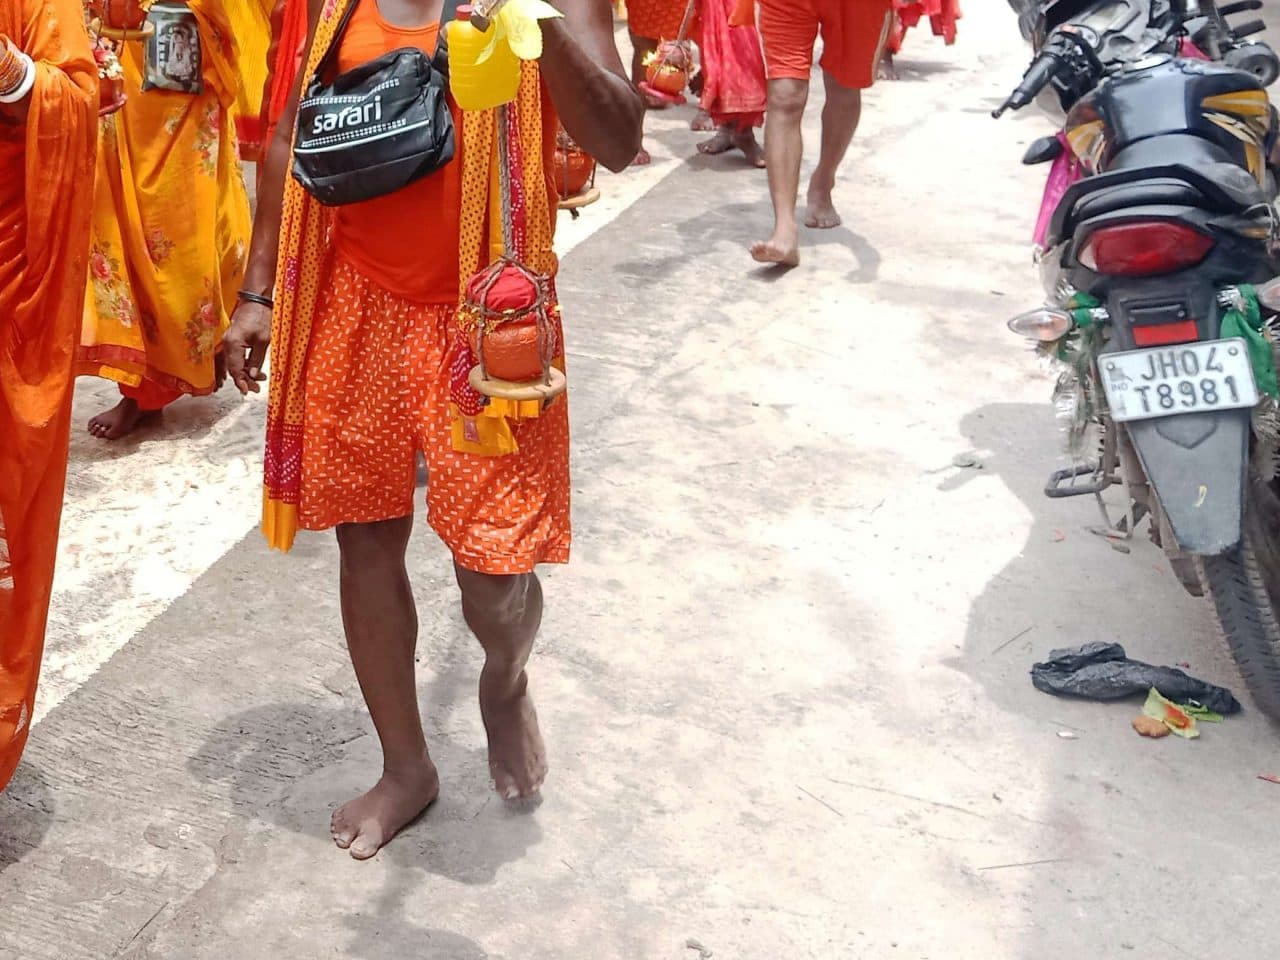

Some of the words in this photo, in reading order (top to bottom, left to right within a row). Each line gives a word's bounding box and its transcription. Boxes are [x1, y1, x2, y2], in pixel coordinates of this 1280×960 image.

[312, 95, 383, 135] safari
[1140, 346, 1223, 381] JH04
[1134, 375, 1240, 413] T8981
